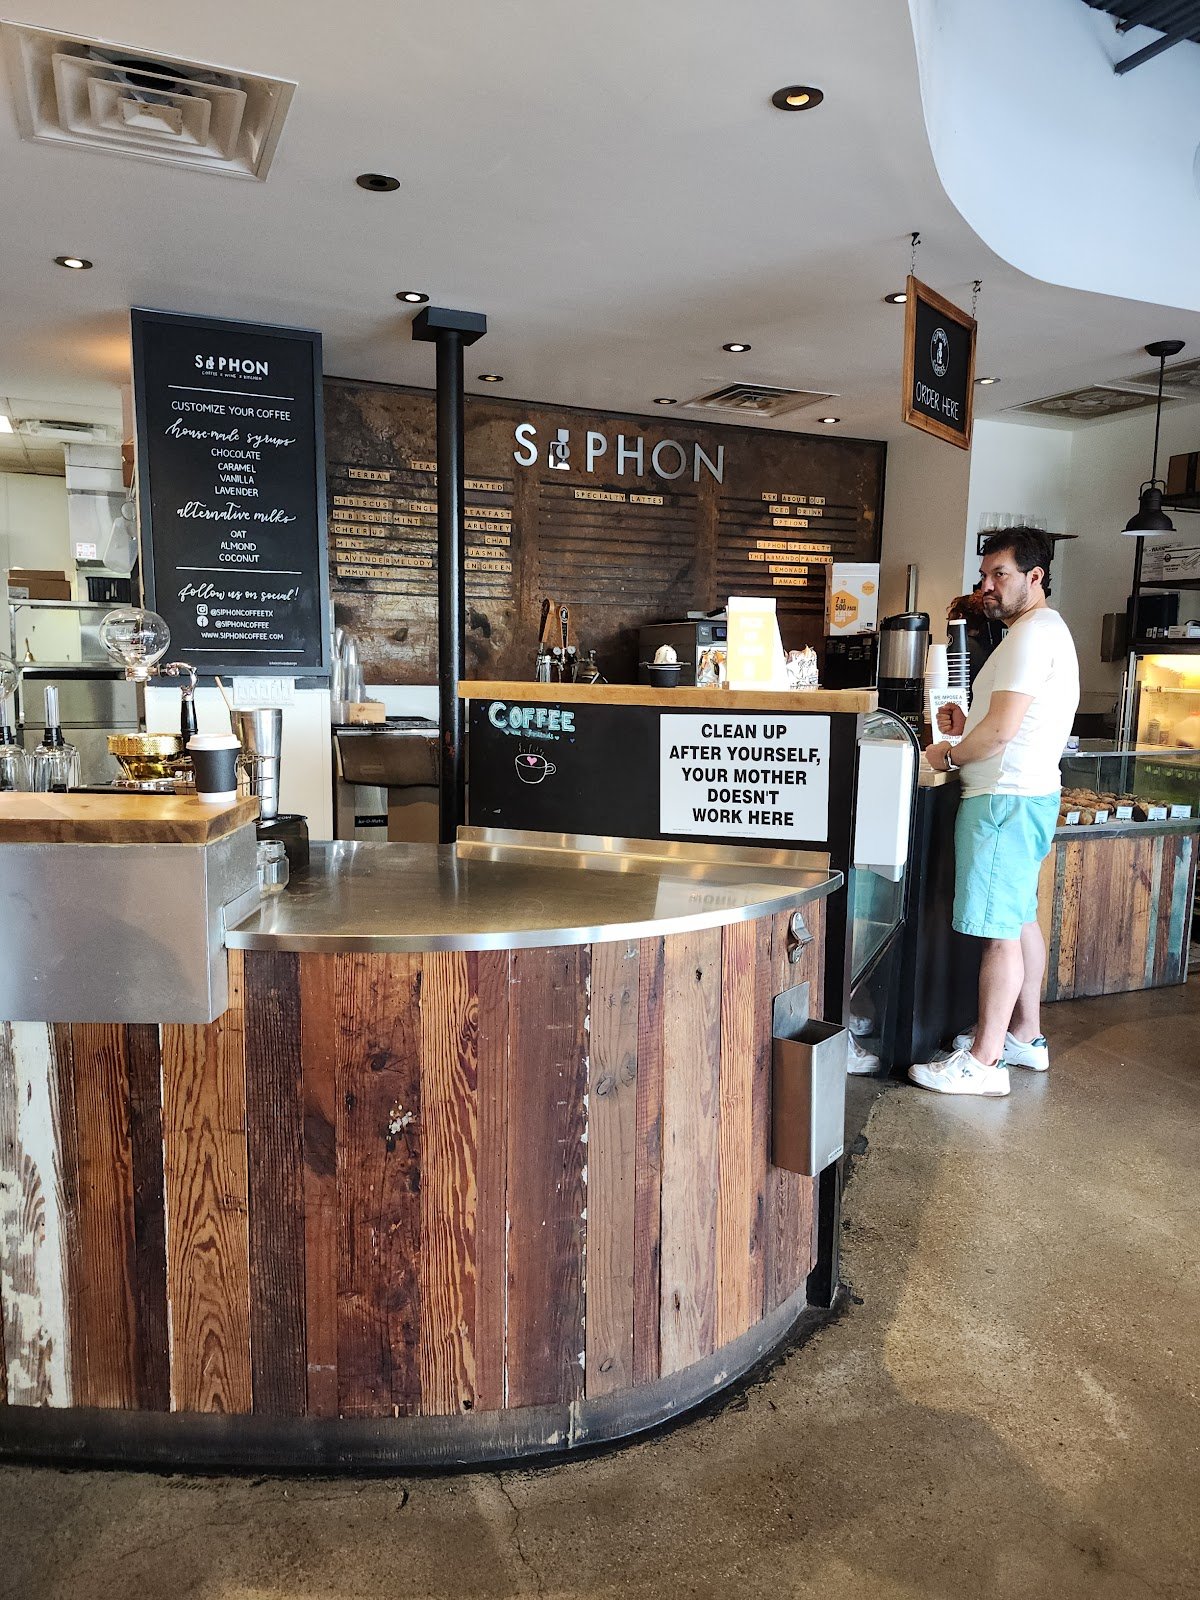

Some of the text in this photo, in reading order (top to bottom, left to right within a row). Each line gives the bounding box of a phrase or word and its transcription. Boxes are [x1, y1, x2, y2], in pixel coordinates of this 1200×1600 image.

[916, 381, 959, 421] ORDER HERE
[172, 400, 291, 421] CUSTOMIZE YOUR COFFEE
[247, 432, 296, 448] syrups
[211, 448, 261, 460] CHOCOLATE
[218, 463, 256, 473] CARAMEL
[220, 474, 254, 484] VANILLA
[215, 486, 259, 497] LAVENDER
[576, 491, 625, 500] SPECIALTY
[334, 498, 387, 508] HIBISCUS
[177, 502, 296, 523] alternative milks
[334, 513, 387, 522] HIBISCUS
[230, 530, 247, 538] OAT
[221, 542, 256, 552] ALMOND
[219, 554, 260, 563] COCONUT
[338, 554, 390, 563] LAVENDER
[178, 583, 299, 602] follow us on social!
[210, 608, 273, 617] @SIPHONCOFFEETX
[215, 620, 269, 629] @SIPHONCOFFEE
[201, 631, 283, 640] WWW.SIPHONCOFFEE.COM
[488, 702, 575, 732] COFFEE
[701, 724, 787, 739] CLEAN UP
[669, 745, 821, 766] AFTER YOURSELF,
[682, 768, 807, 785] YOUR MOTHER
[708, 789, 779, 804] DOESN'T
[692, 808, 794, 826] WORK HERE
